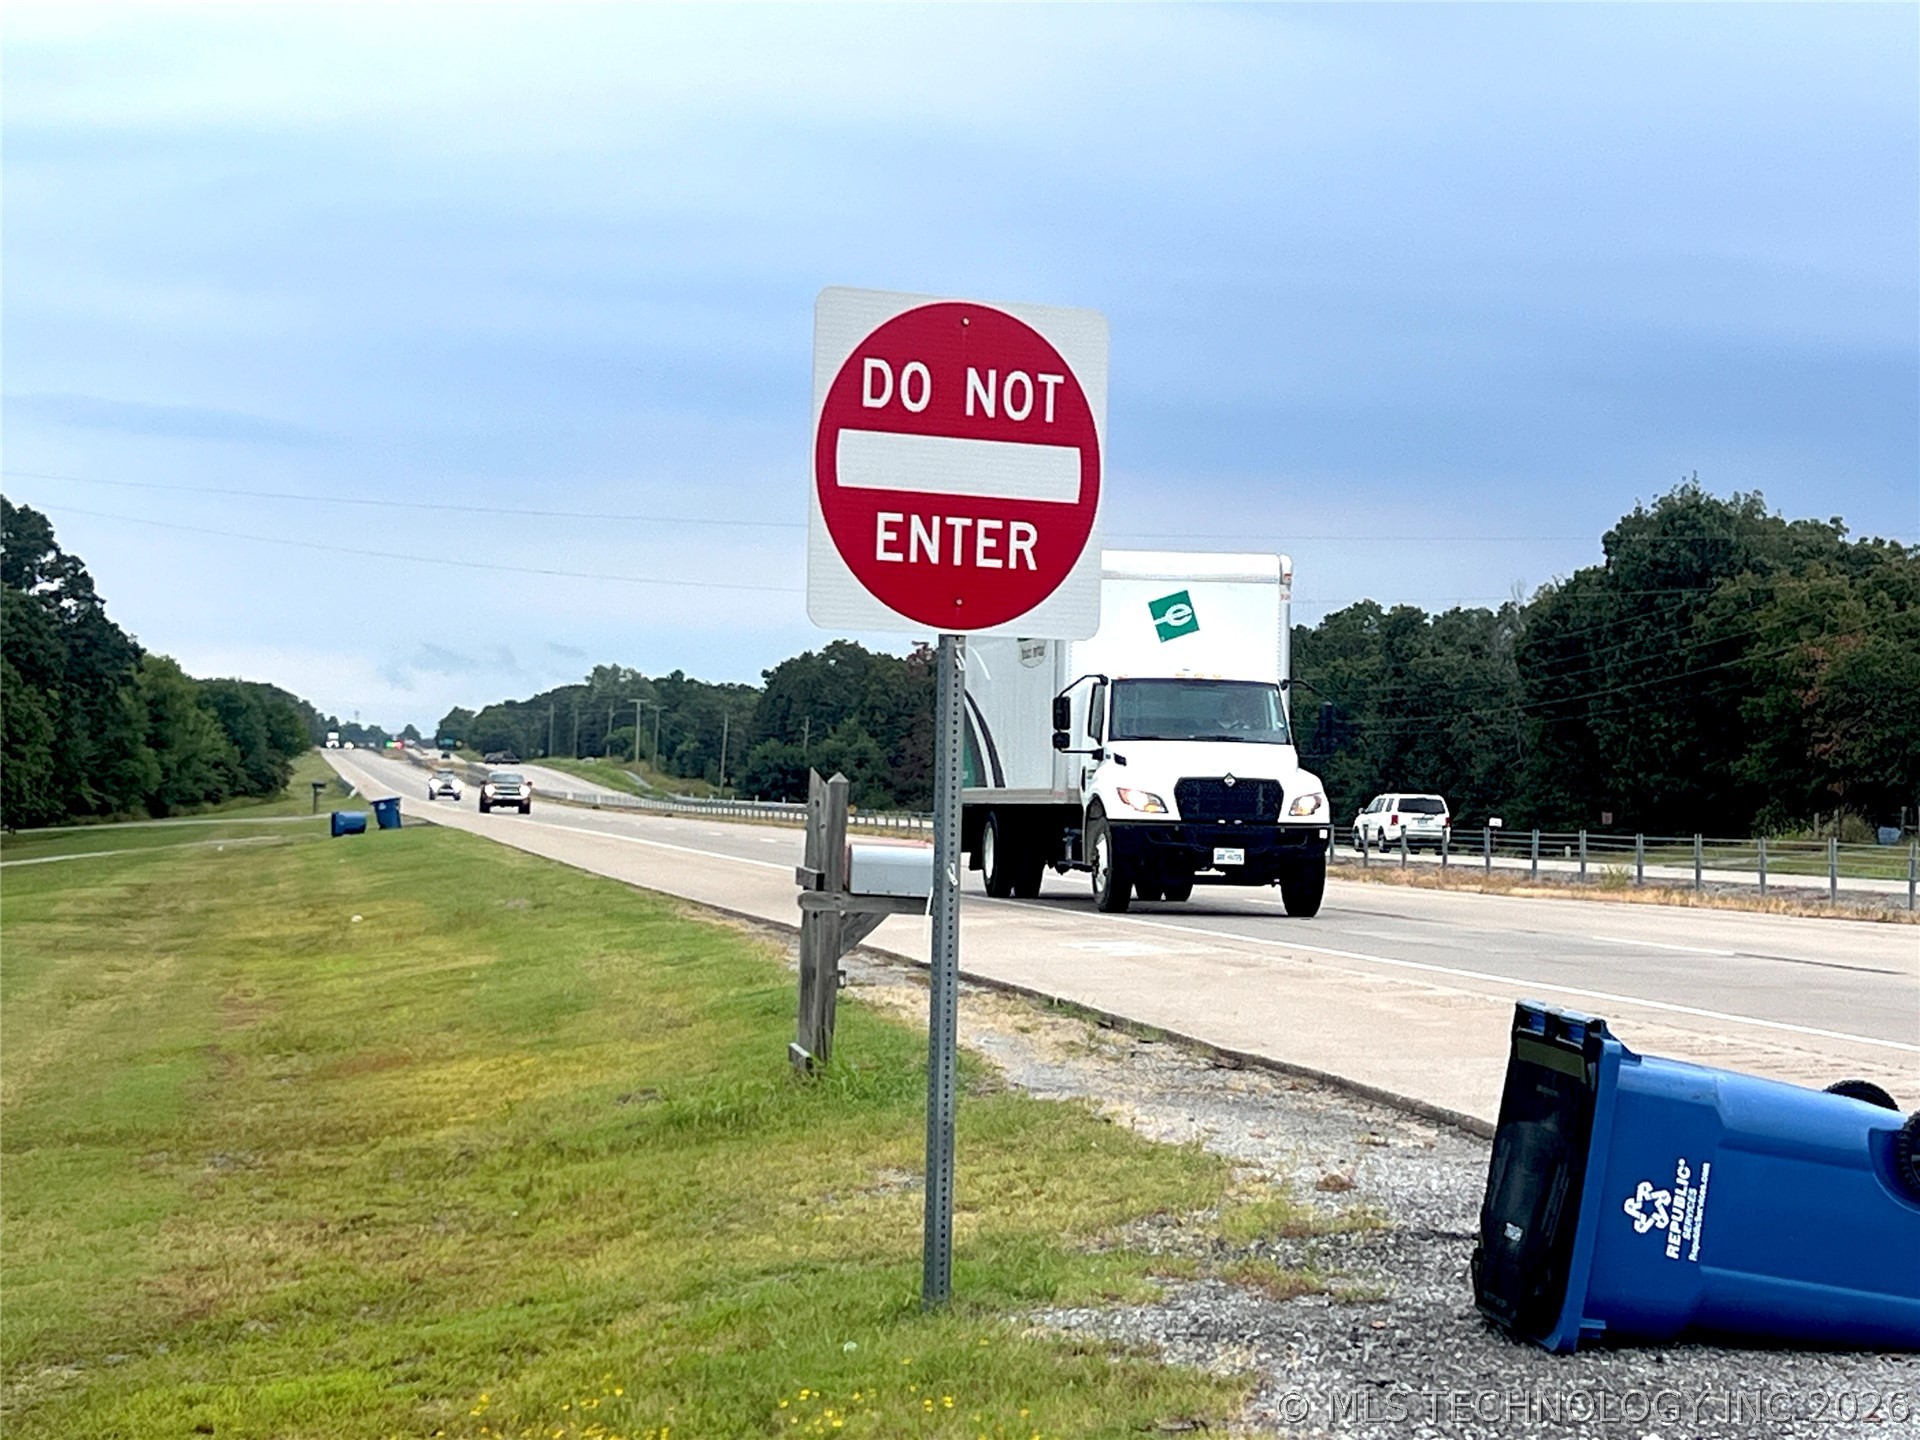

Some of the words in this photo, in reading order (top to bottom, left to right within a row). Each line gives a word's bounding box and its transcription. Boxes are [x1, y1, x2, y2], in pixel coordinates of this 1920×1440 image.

[863, 357, 931, 412] DO
[965, 366, 1065, 424] NOT
[876, 512, 1038, 570] ENTER
[1682, 1187, 1697, 1240] SERVICES
